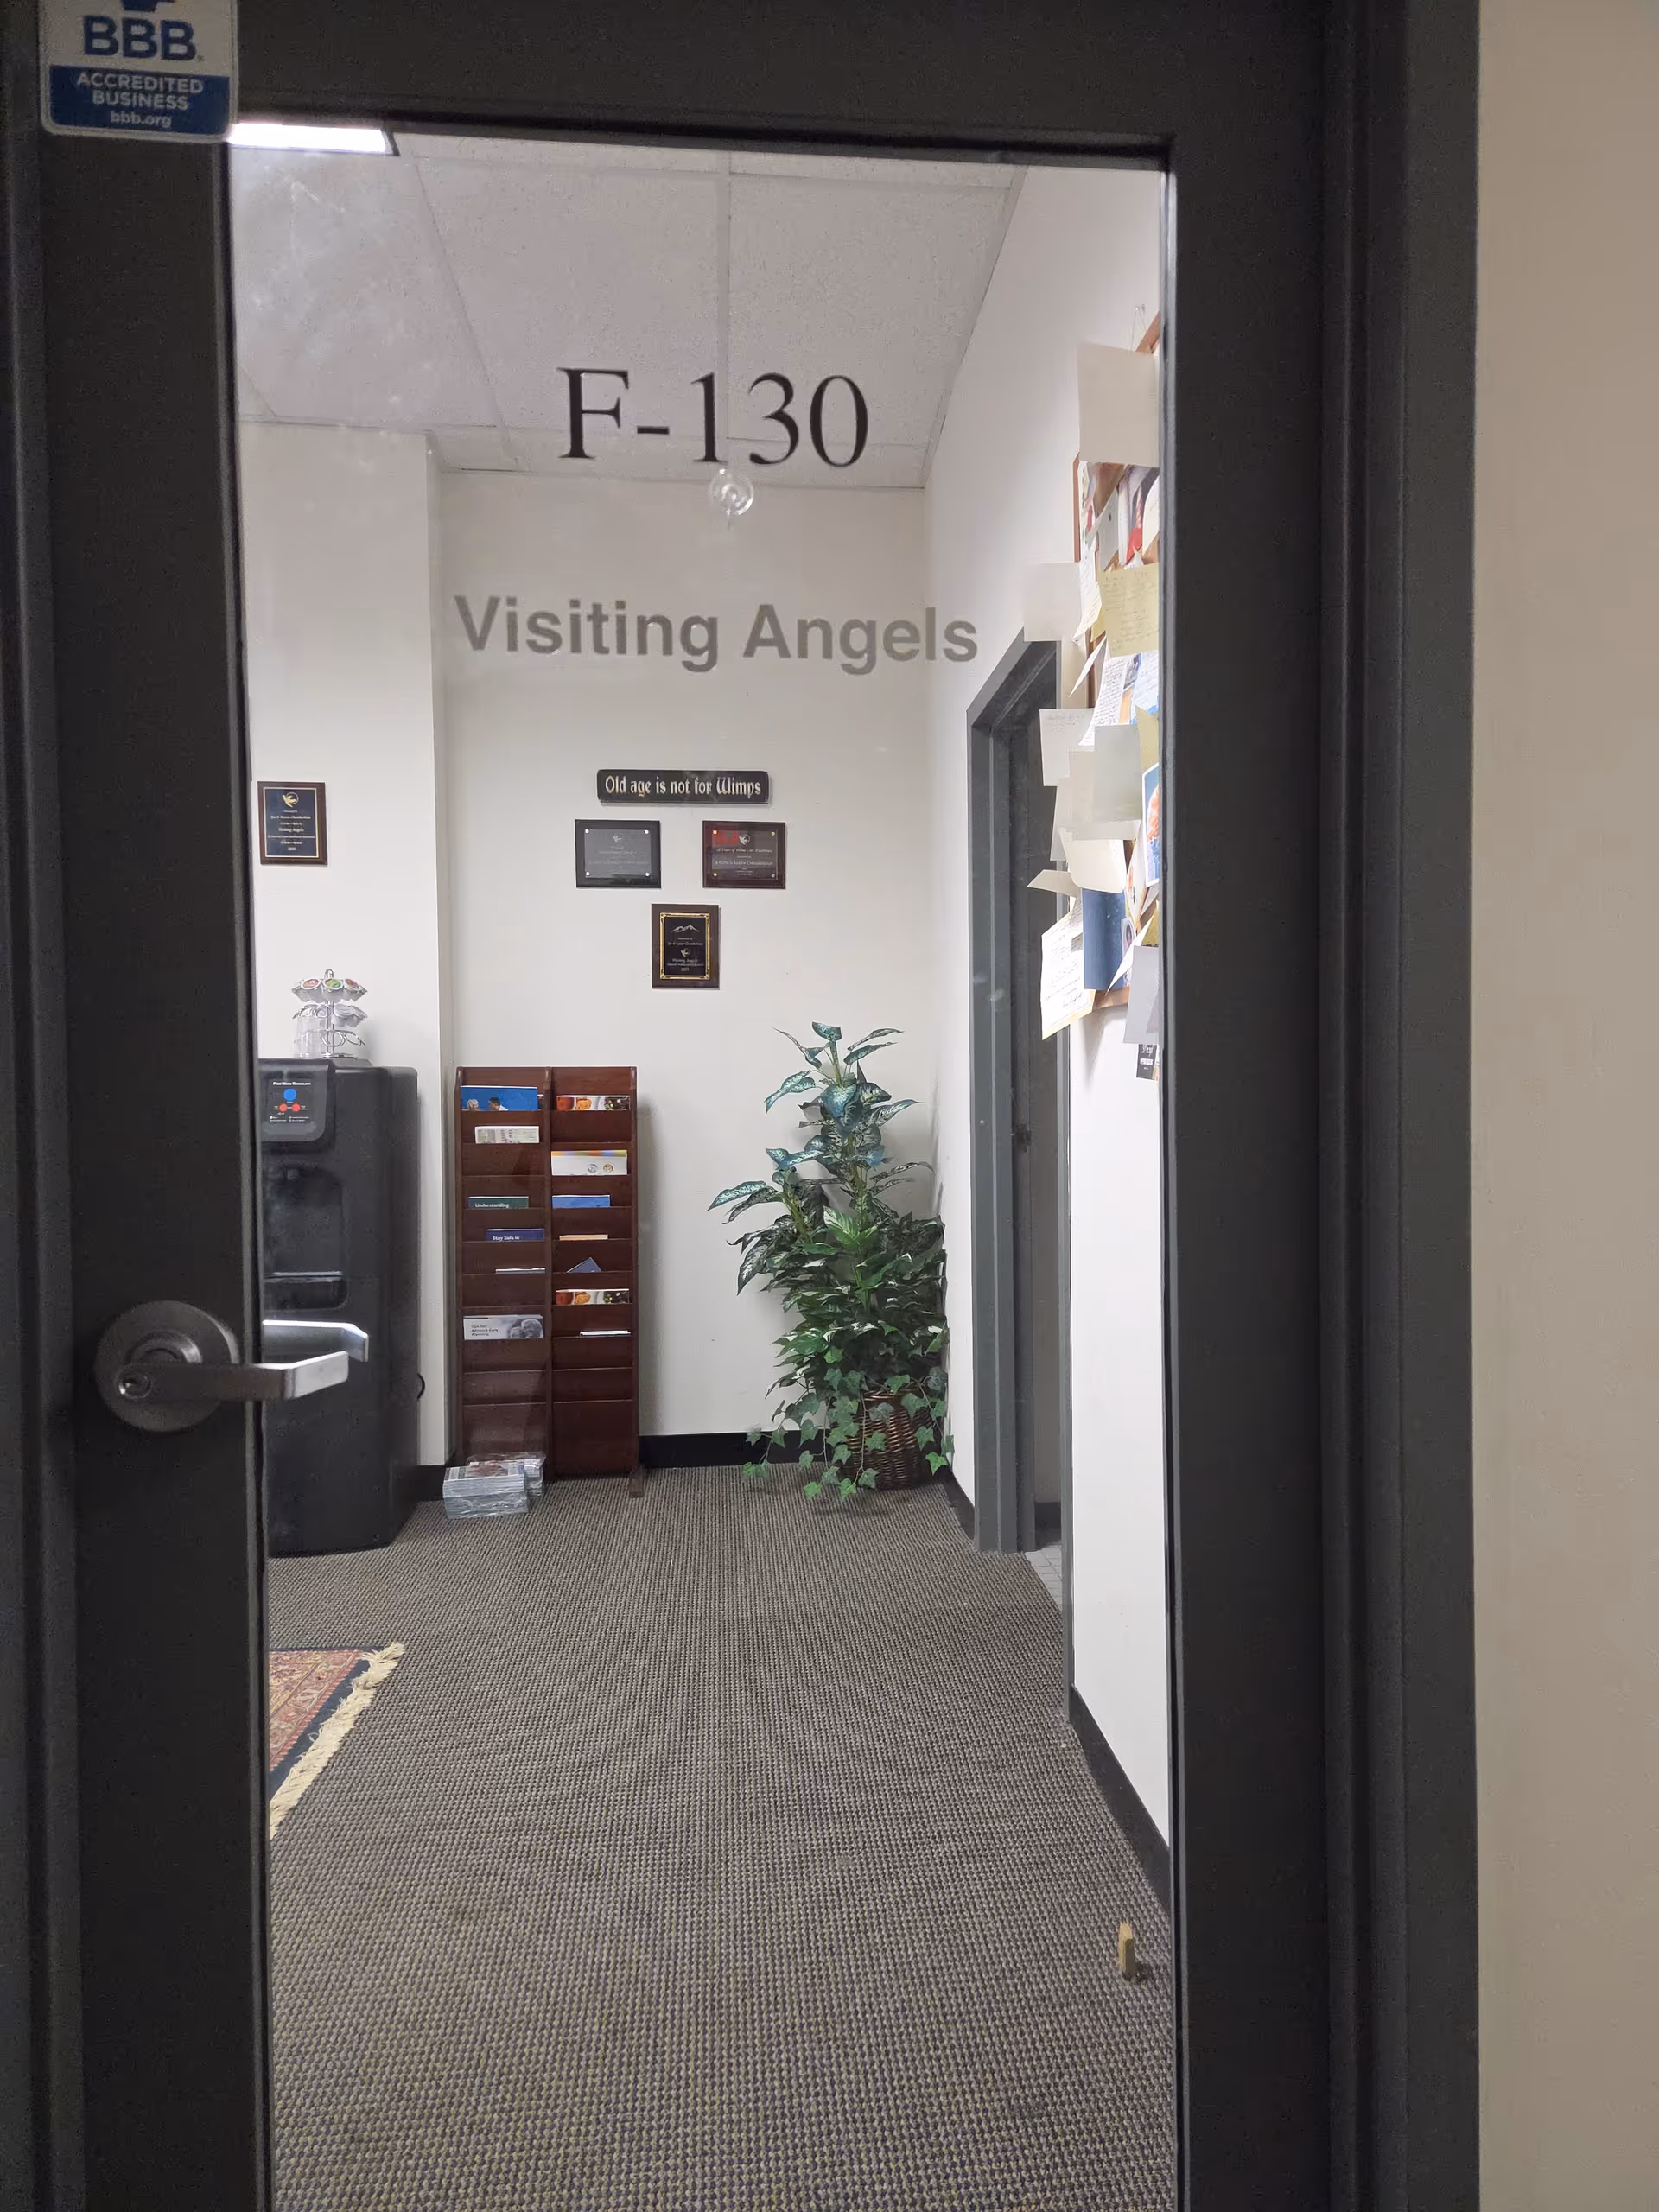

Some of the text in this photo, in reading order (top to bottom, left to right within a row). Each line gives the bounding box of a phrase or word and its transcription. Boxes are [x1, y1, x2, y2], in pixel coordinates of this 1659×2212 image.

[83, 15, 197, 60] BBB
[76, 71, 204, 93] ACCREDITED
[92, 89, 189, 111] BUSINESS
[110, 110, 173, 128] bbb.org
[557, 366, 869, 468] F-130
[454, 594, 979, 676] Visiting Angels
[605, 775, 761, 799] Old age is not for Wimps
